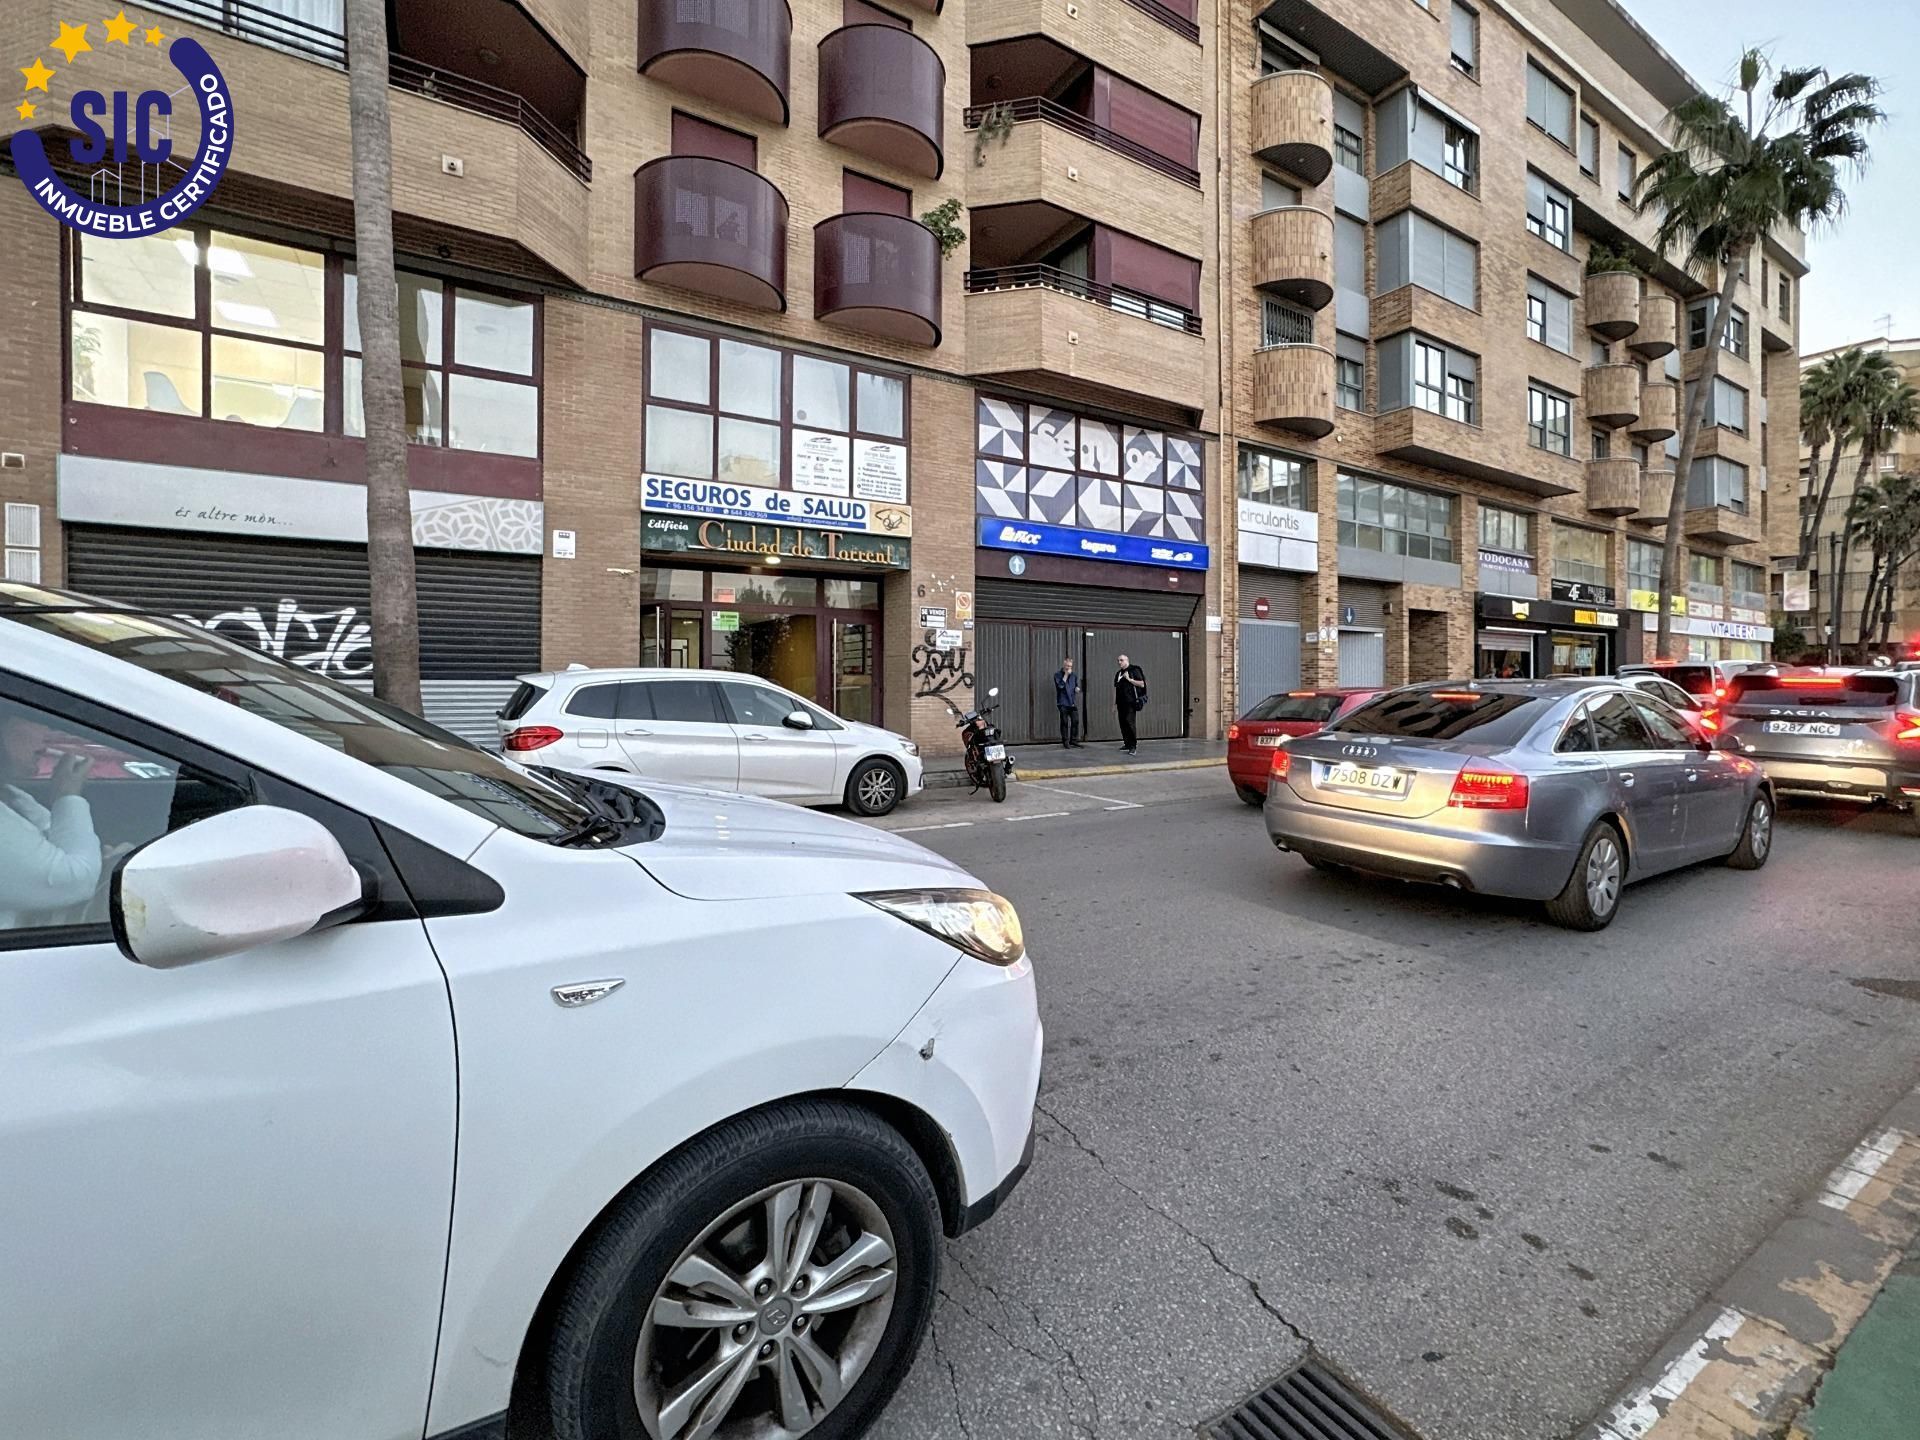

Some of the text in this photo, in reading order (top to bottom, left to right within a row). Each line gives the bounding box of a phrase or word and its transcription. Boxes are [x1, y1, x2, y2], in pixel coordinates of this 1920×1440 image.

[646, 478, 867, 520] SEGUROS de SALUD
[197, 506, 239, 521] altre
[1240, 508, 1300, 531] circulantis
[698, 520, 780, 554] Ciudad
[792, 529, 813, 557] de
[1477, 551, 1530, 569] TODOCASA
[917, 584, 926, 598] 6
[929, 609, 946, 617] VENDE
[1770, 708, 1830, 717] DACIA
[1772, 720, 1836, 735] 9287 NCC
[1331, 767, 1402, 790] 7508 DZW
